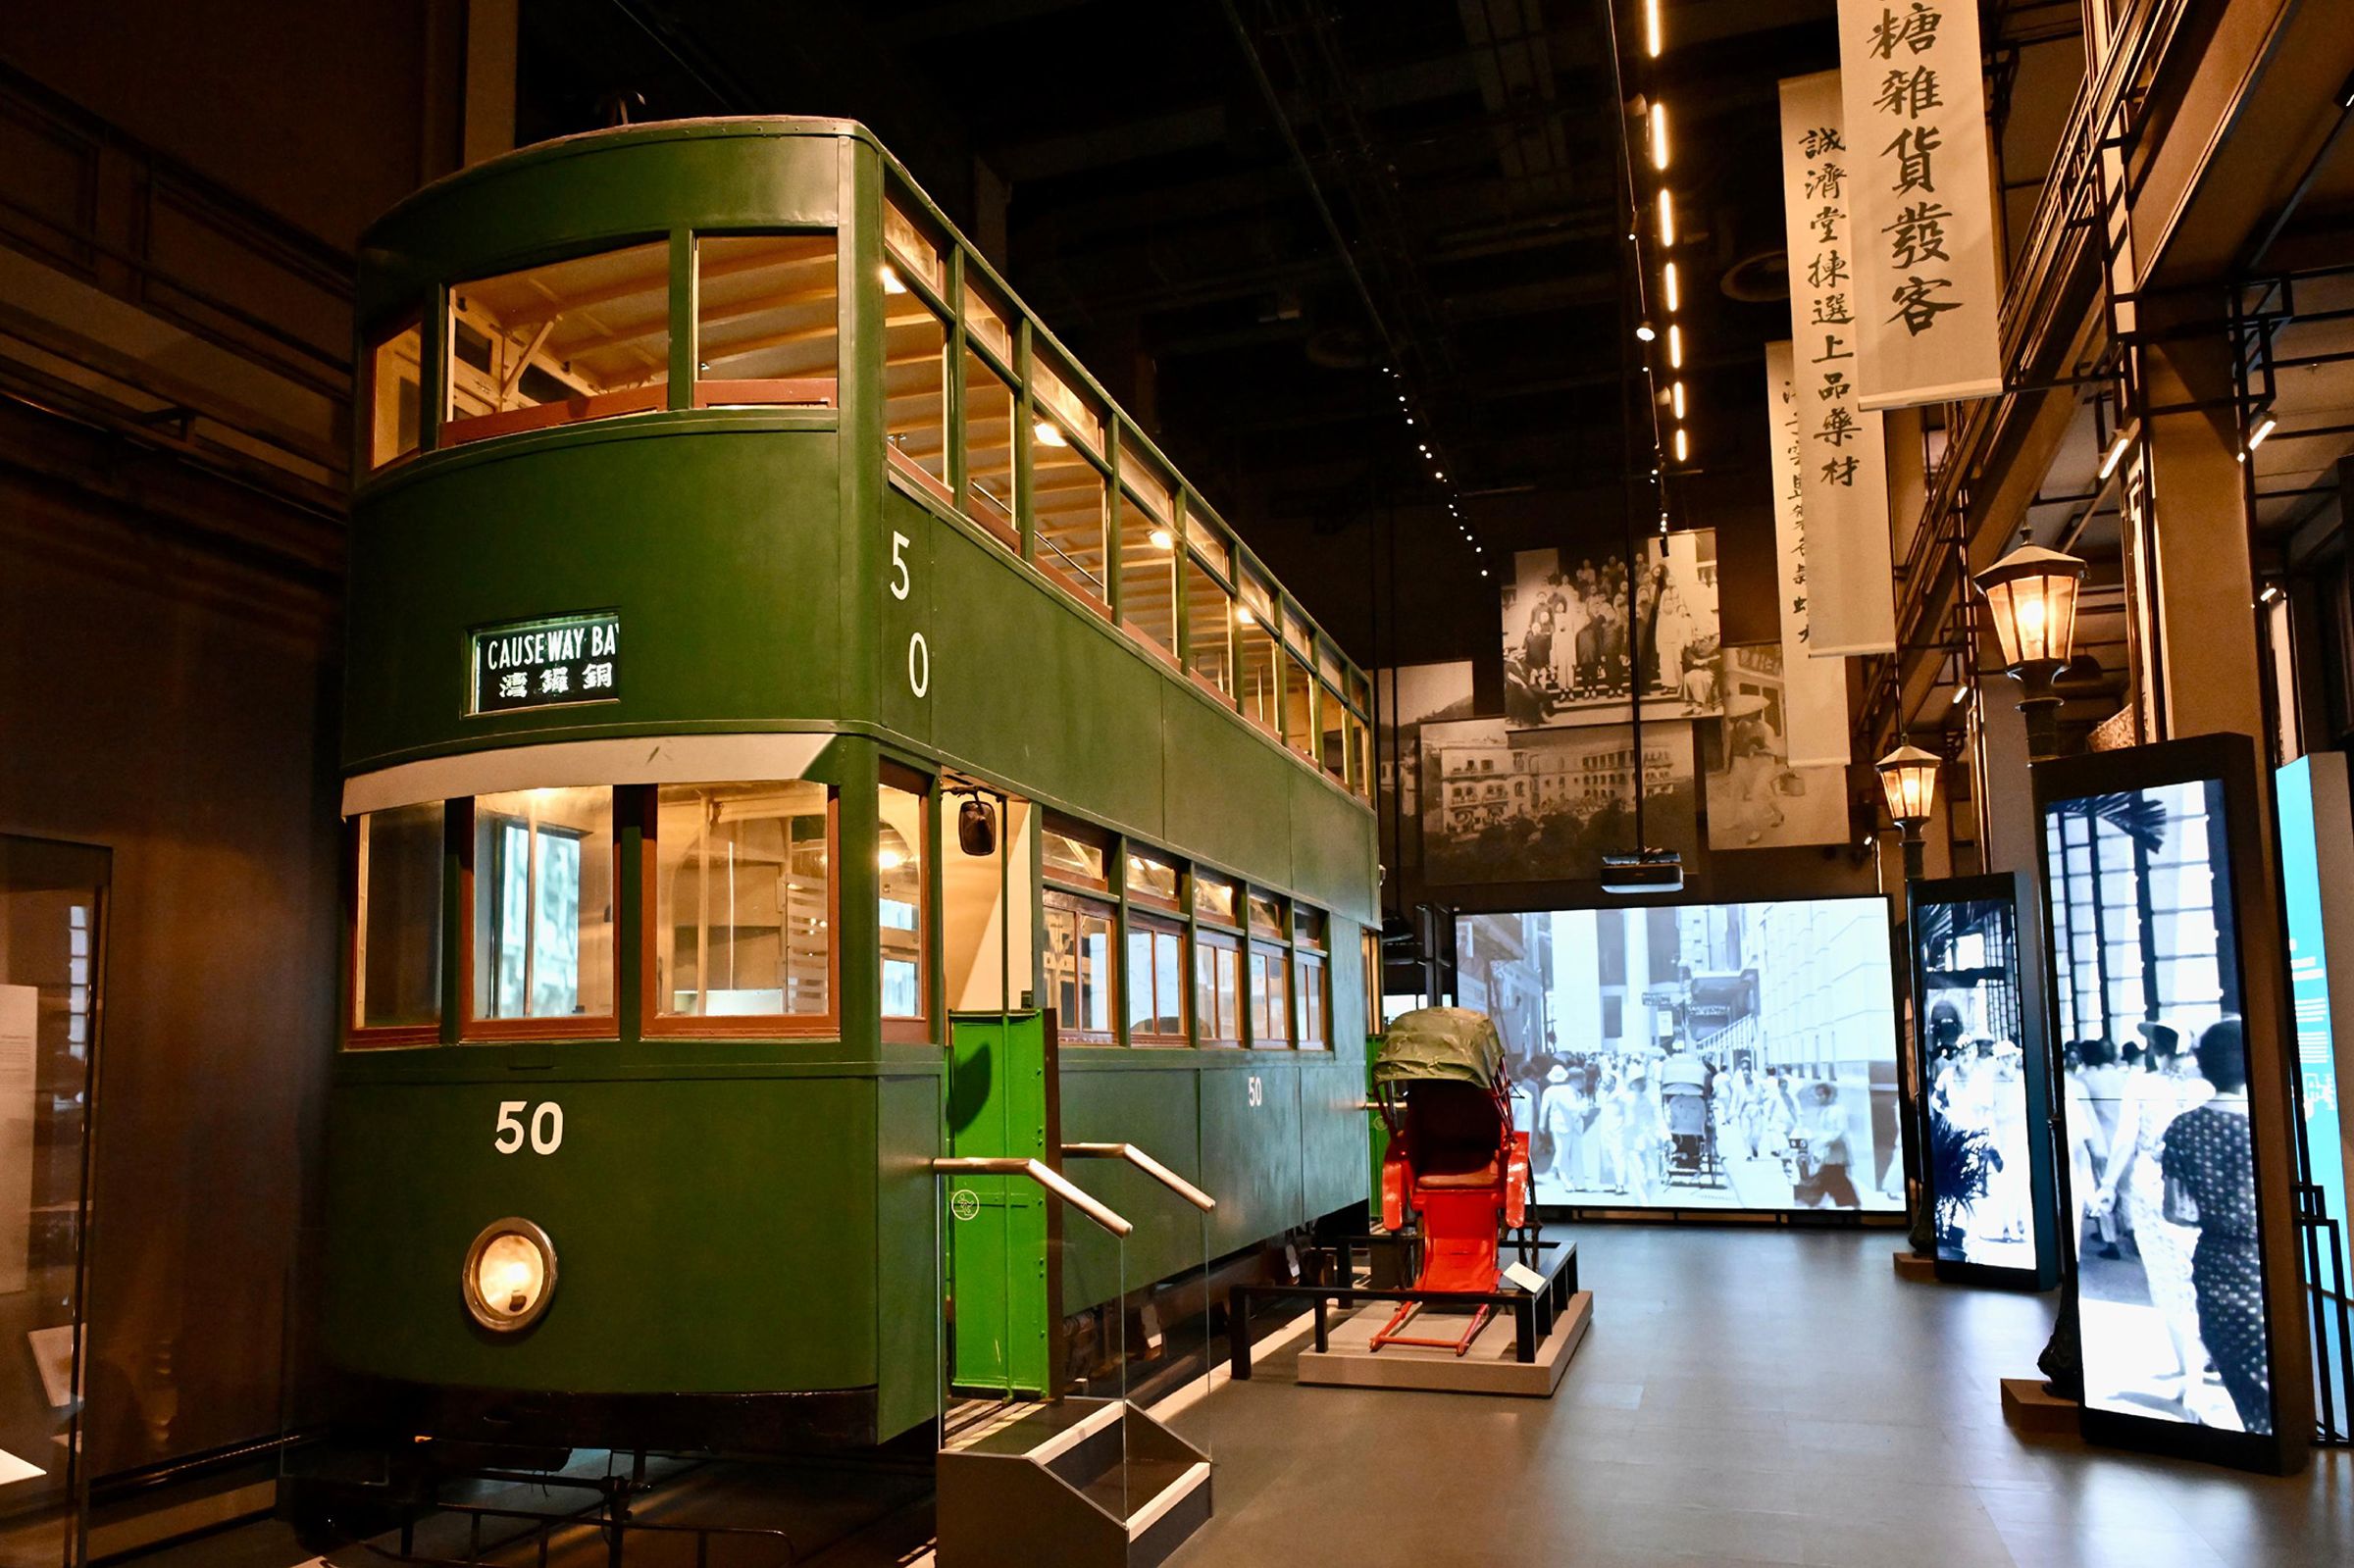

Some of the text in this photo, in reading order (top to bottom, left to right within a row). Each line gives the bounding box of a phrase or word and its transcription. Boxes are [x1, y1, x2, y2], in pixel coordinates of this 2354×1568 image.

[1867, 3, 1964, 337] 糖雜貨發客
[487, 623, 620, 670] CAUSEWAY BA
[1249, 1076, 1262, 1107] 50
[494, 1100, 564, 1155] 50
